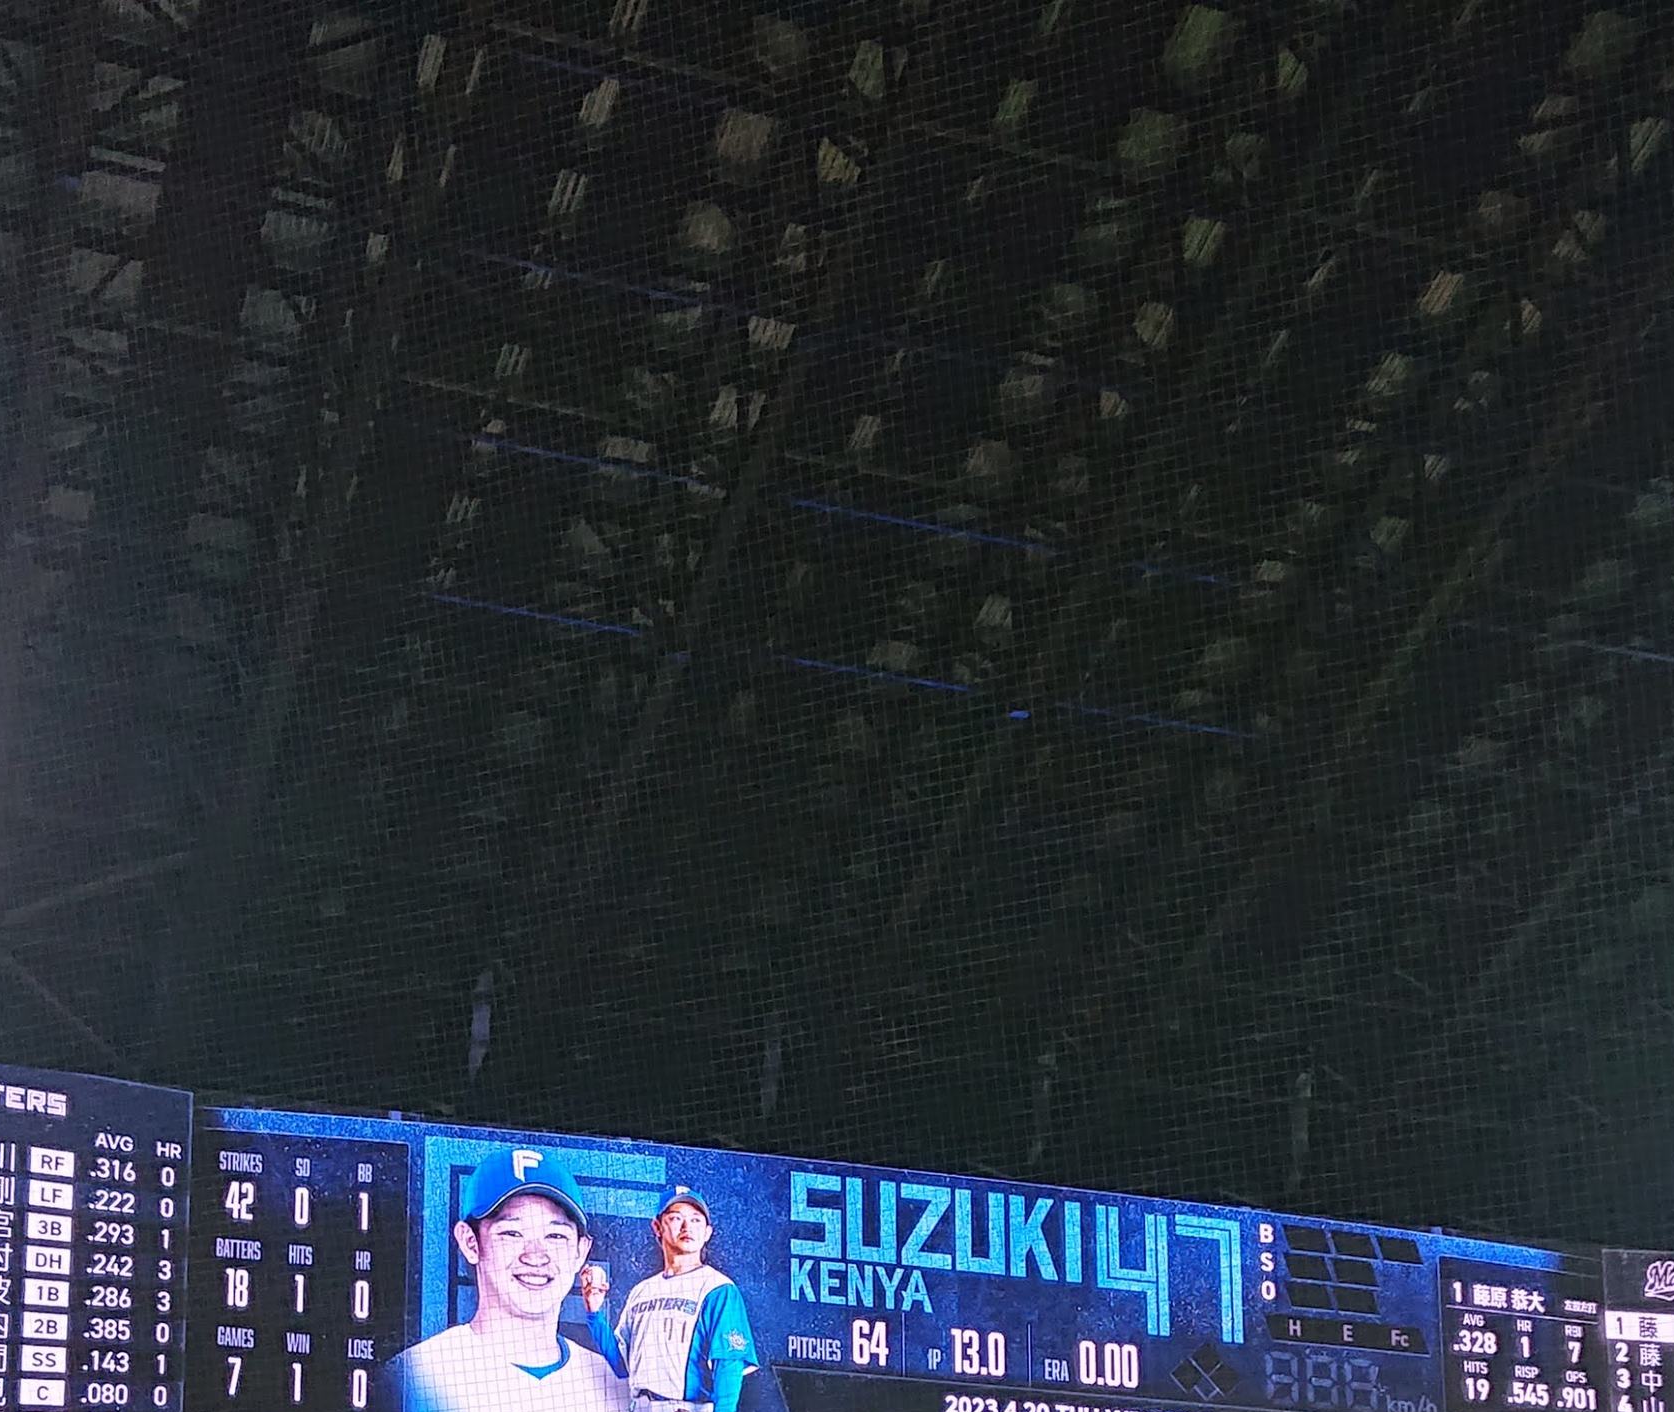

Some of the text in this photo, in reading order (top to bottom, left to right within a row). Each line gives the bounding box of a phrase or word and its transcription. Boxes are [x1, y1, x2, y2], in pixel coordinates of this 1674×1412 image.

[95, 1132, 182, 1159] AVG HR
[89, 1157, 137, 1183] .316
[219, 1151, 263, 1174] STRIKES
[357, 1163, 373, 1183] BB
[88, 1190, 136, 1214] .222
[225, 1181, 254, 1221] 42
[87, 1223, 135, 1245] .293
[85, 1254, 133, 1278] .242
[216, 1237, 371, 1271] BATTERS HITS HR
[789, 1170, 1245, 1344] SUZUKI 47
[84, 1287, 132, 1309] .286
[225, 1267, 250, 1308] 18
[789, 1257, 933, 1314] KENYA
[82, 1319, 130, 1340] .385
[1453, 1330, 1498, 1355] .328
[217, 1326, 374, 1360] GAMES WIN LOSE
[788, 1335, 842, 1363] PITCHES
[851, 1318, 889, 1367] 64
[950, 1327, 1006, 1377] 13.0
[1044, 1358, 1069, 1383] ERA
[1078, 1339, 1138, 1389] 0.00
[82, 1351, 130, 1373] .143
[1464, 1361, 1488, 1375] HITS
[1515, 1366, 1539, 1379] RISP
[80, 1382, 128, 1405] .080
[1465, 1379, 1598, 1411] 19 .545 .901
